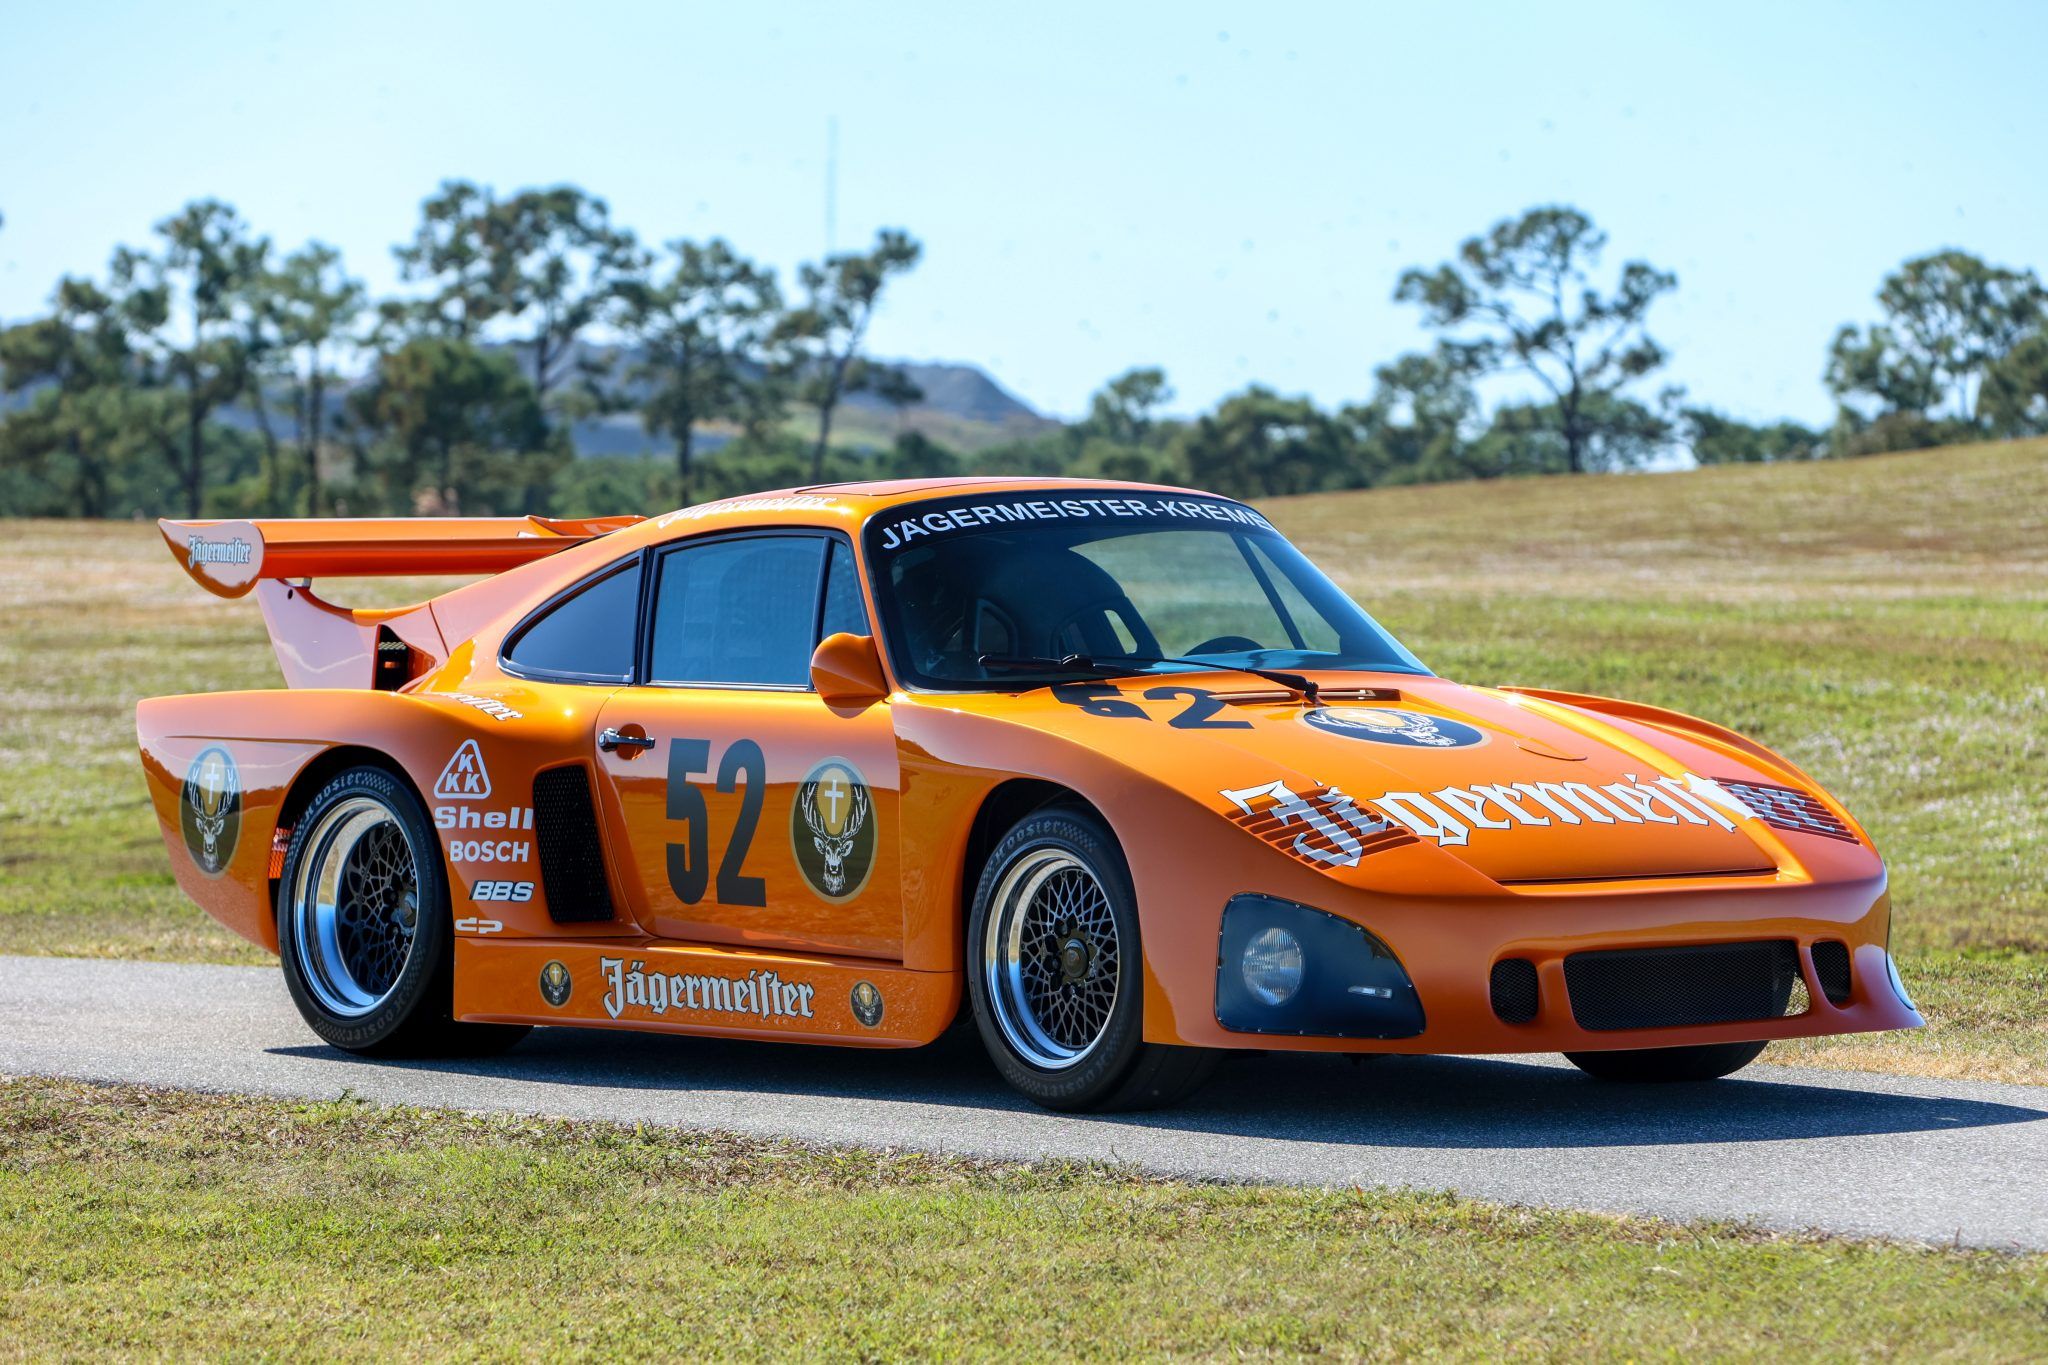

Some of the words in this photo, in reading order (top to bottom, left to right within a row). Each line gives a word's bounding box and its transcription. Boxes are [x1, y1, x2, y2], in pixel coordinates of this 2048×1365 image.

[188, 535, 251, 569] Jägermeister
[1051, 684, 1255, 729] 52
[304, 772, 362, 821] Hoosier
[434, 806, 534, 830] Shell
[666, 738, 767, 907] 52
[995, 820, 1061, 863] Hoosier
[450, 840, 529, 863] BOSCH
[470, 880, 535, 902] BBS
[600, 956, 815, 1020] Jägermeister
